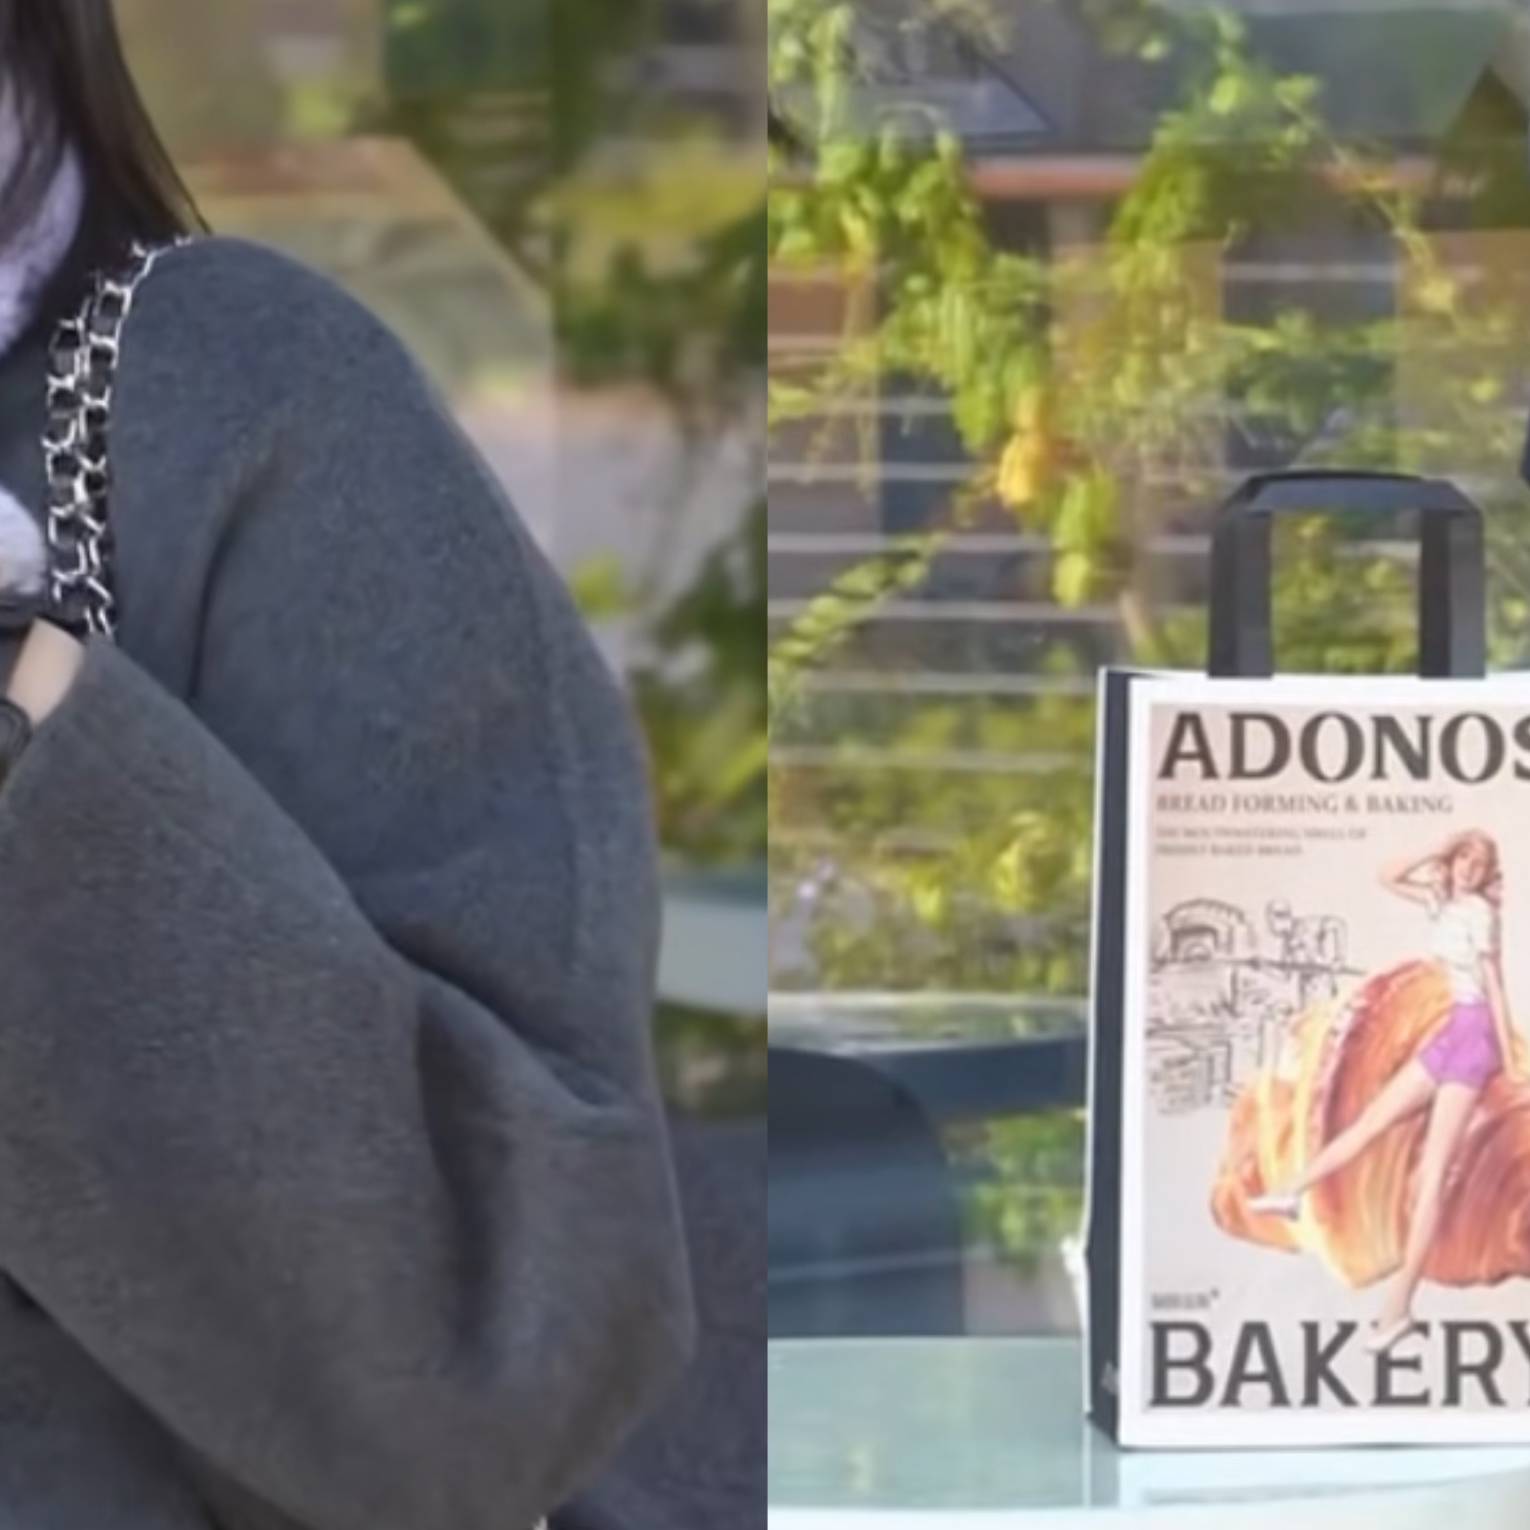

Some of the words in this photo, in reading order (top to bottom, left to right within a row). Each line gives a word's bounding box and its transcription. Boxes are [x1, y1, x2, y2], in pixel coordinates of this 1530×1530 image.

[1155, 793, 1226, 814] BREAD
[1232, 793, 1339, 814] FORMING
[1344, 793, 1360, 814] &
[1366, 793, 1454, 815] BAKING
